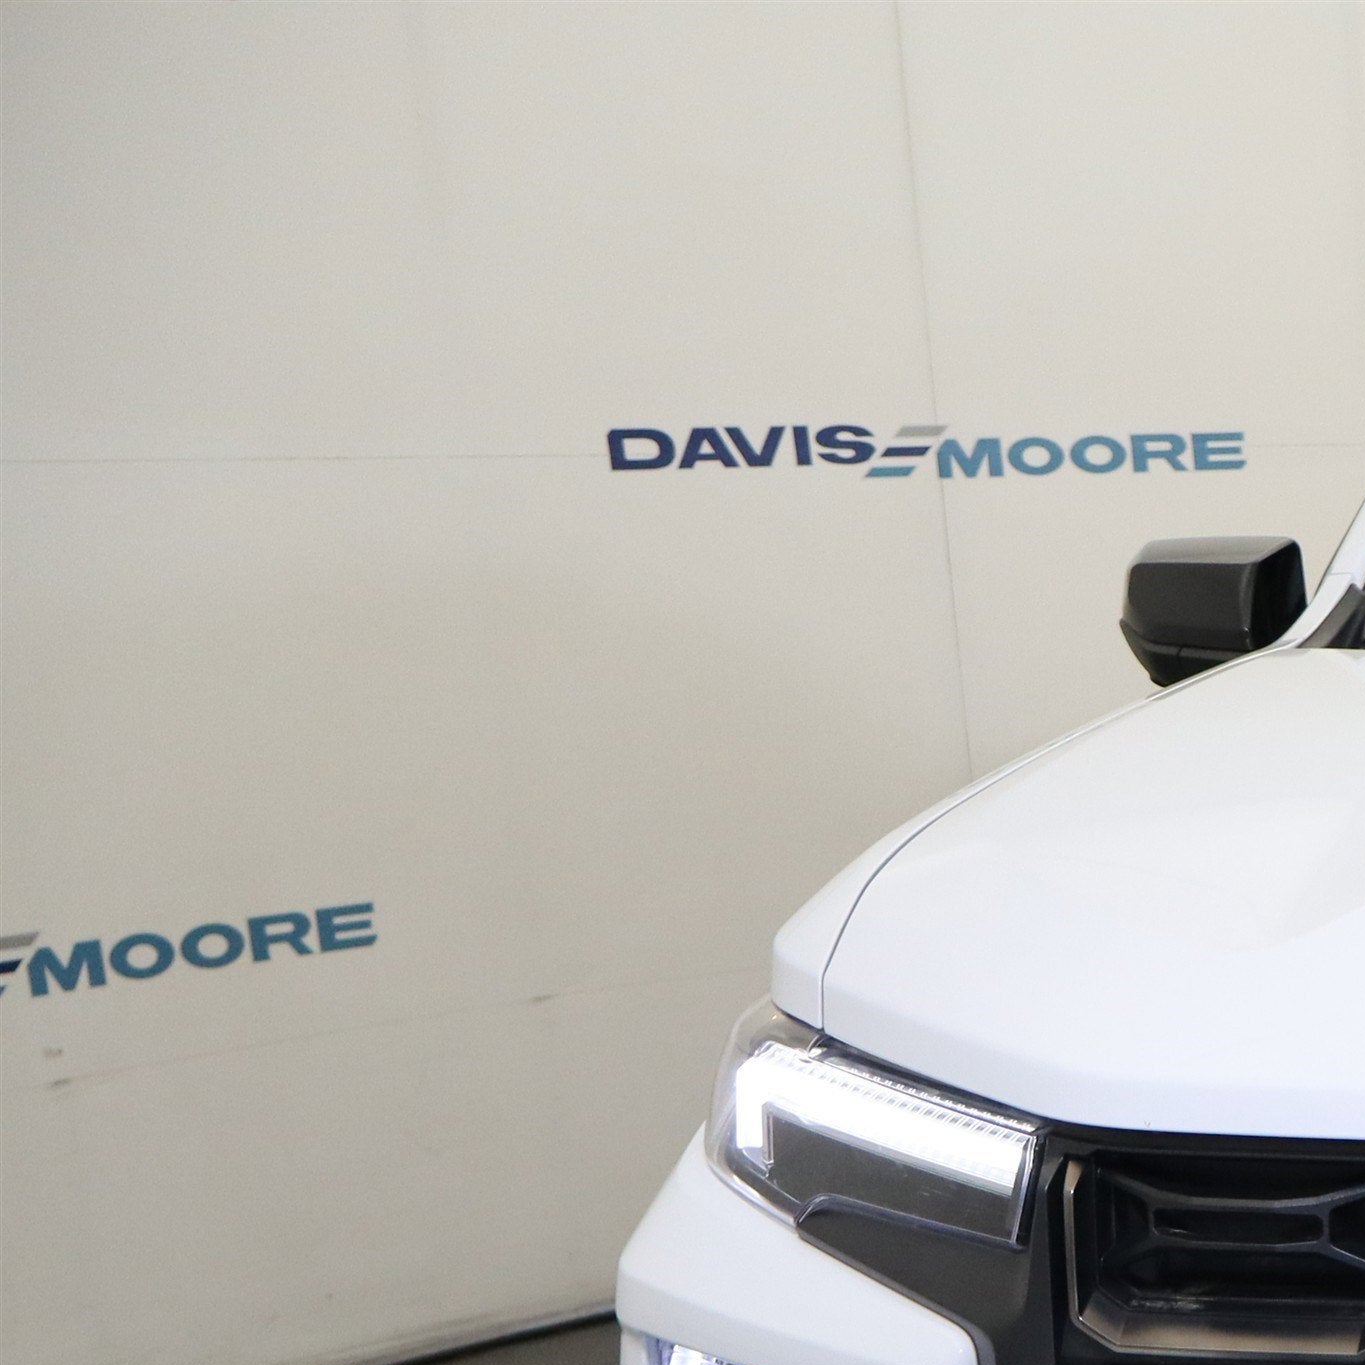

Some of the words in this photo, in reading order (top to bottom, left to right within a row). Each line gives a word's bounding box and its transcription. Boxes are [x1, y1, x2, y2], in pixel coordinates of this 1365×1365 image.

[608, 424, 876, 470] DAVIS
[937, 432, 1247, 478] MOORE
[27, 902, 378, 997] MOORE
